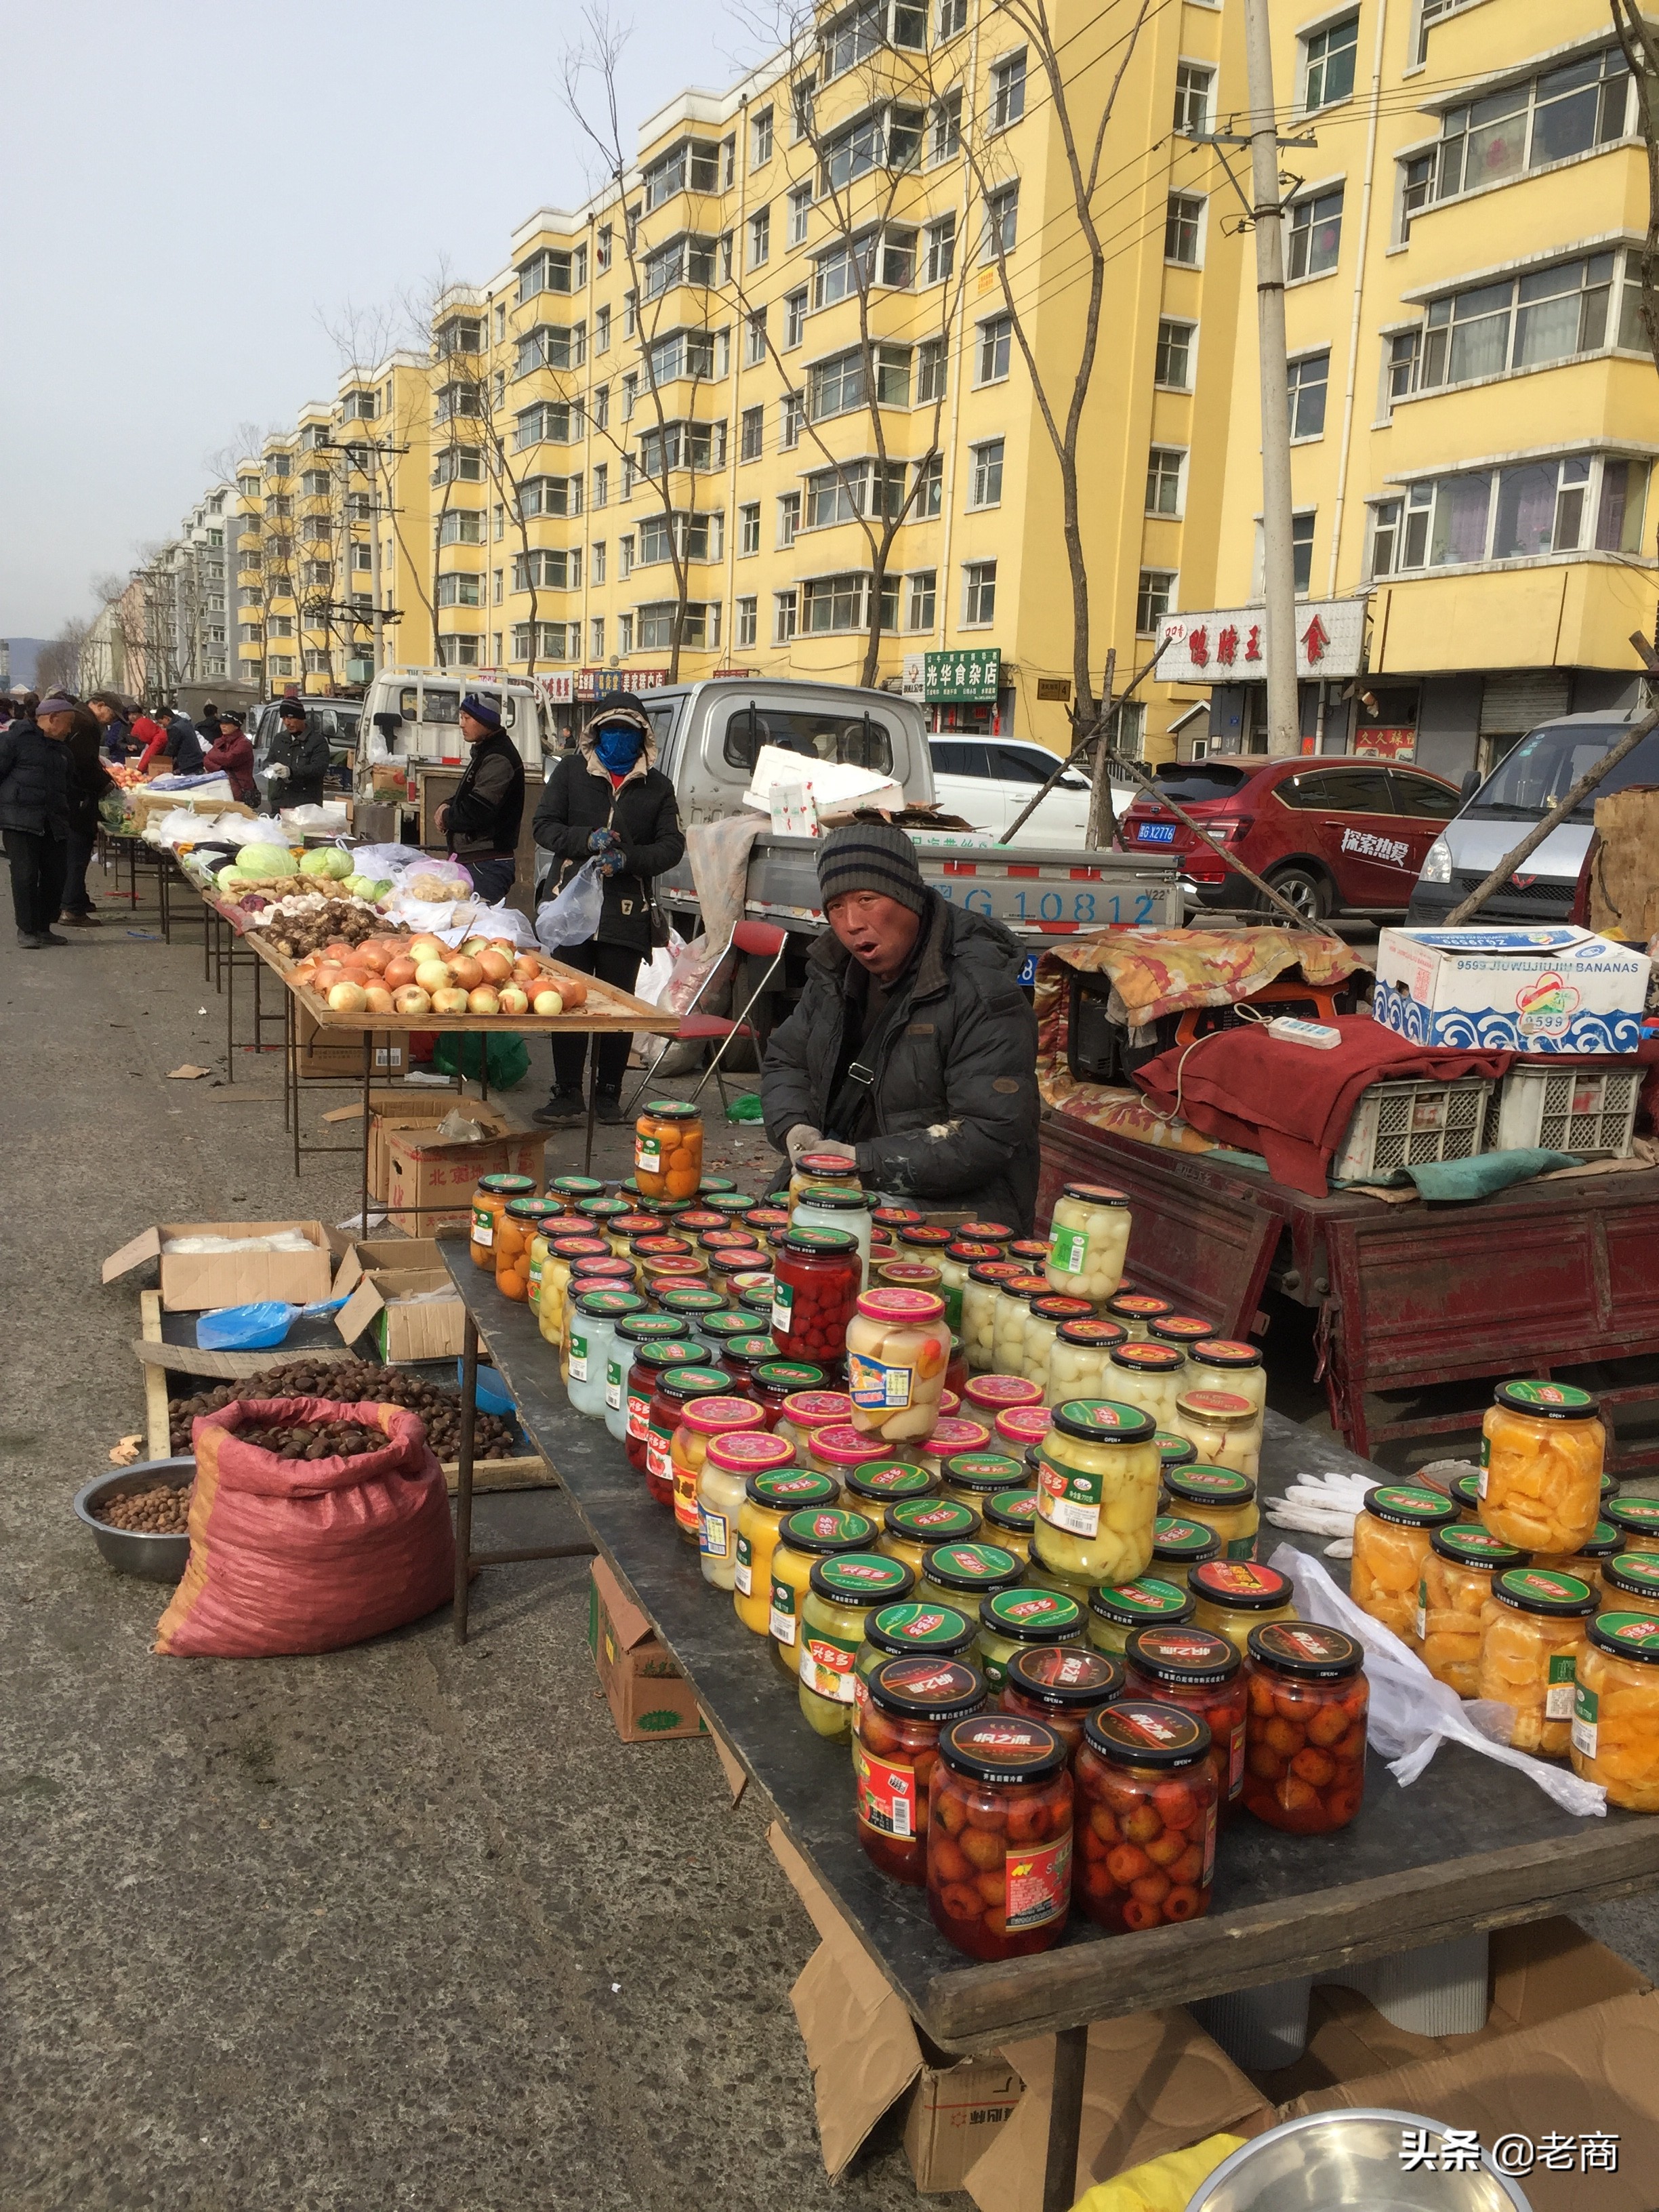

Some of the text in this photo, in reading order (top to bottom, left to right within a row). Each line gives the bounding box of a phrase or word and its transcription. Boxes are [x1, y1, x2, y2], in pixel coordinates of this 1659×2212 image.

[926, 661, 997, 687] 光华食杂店
[1341, 827, 1410, 867] 探索热爱
[1457, 960, 1486, 971] 9599
[1576, 962, 1639, 973] BANANAS
[813, 1645, 848, 1667] 兴多多
